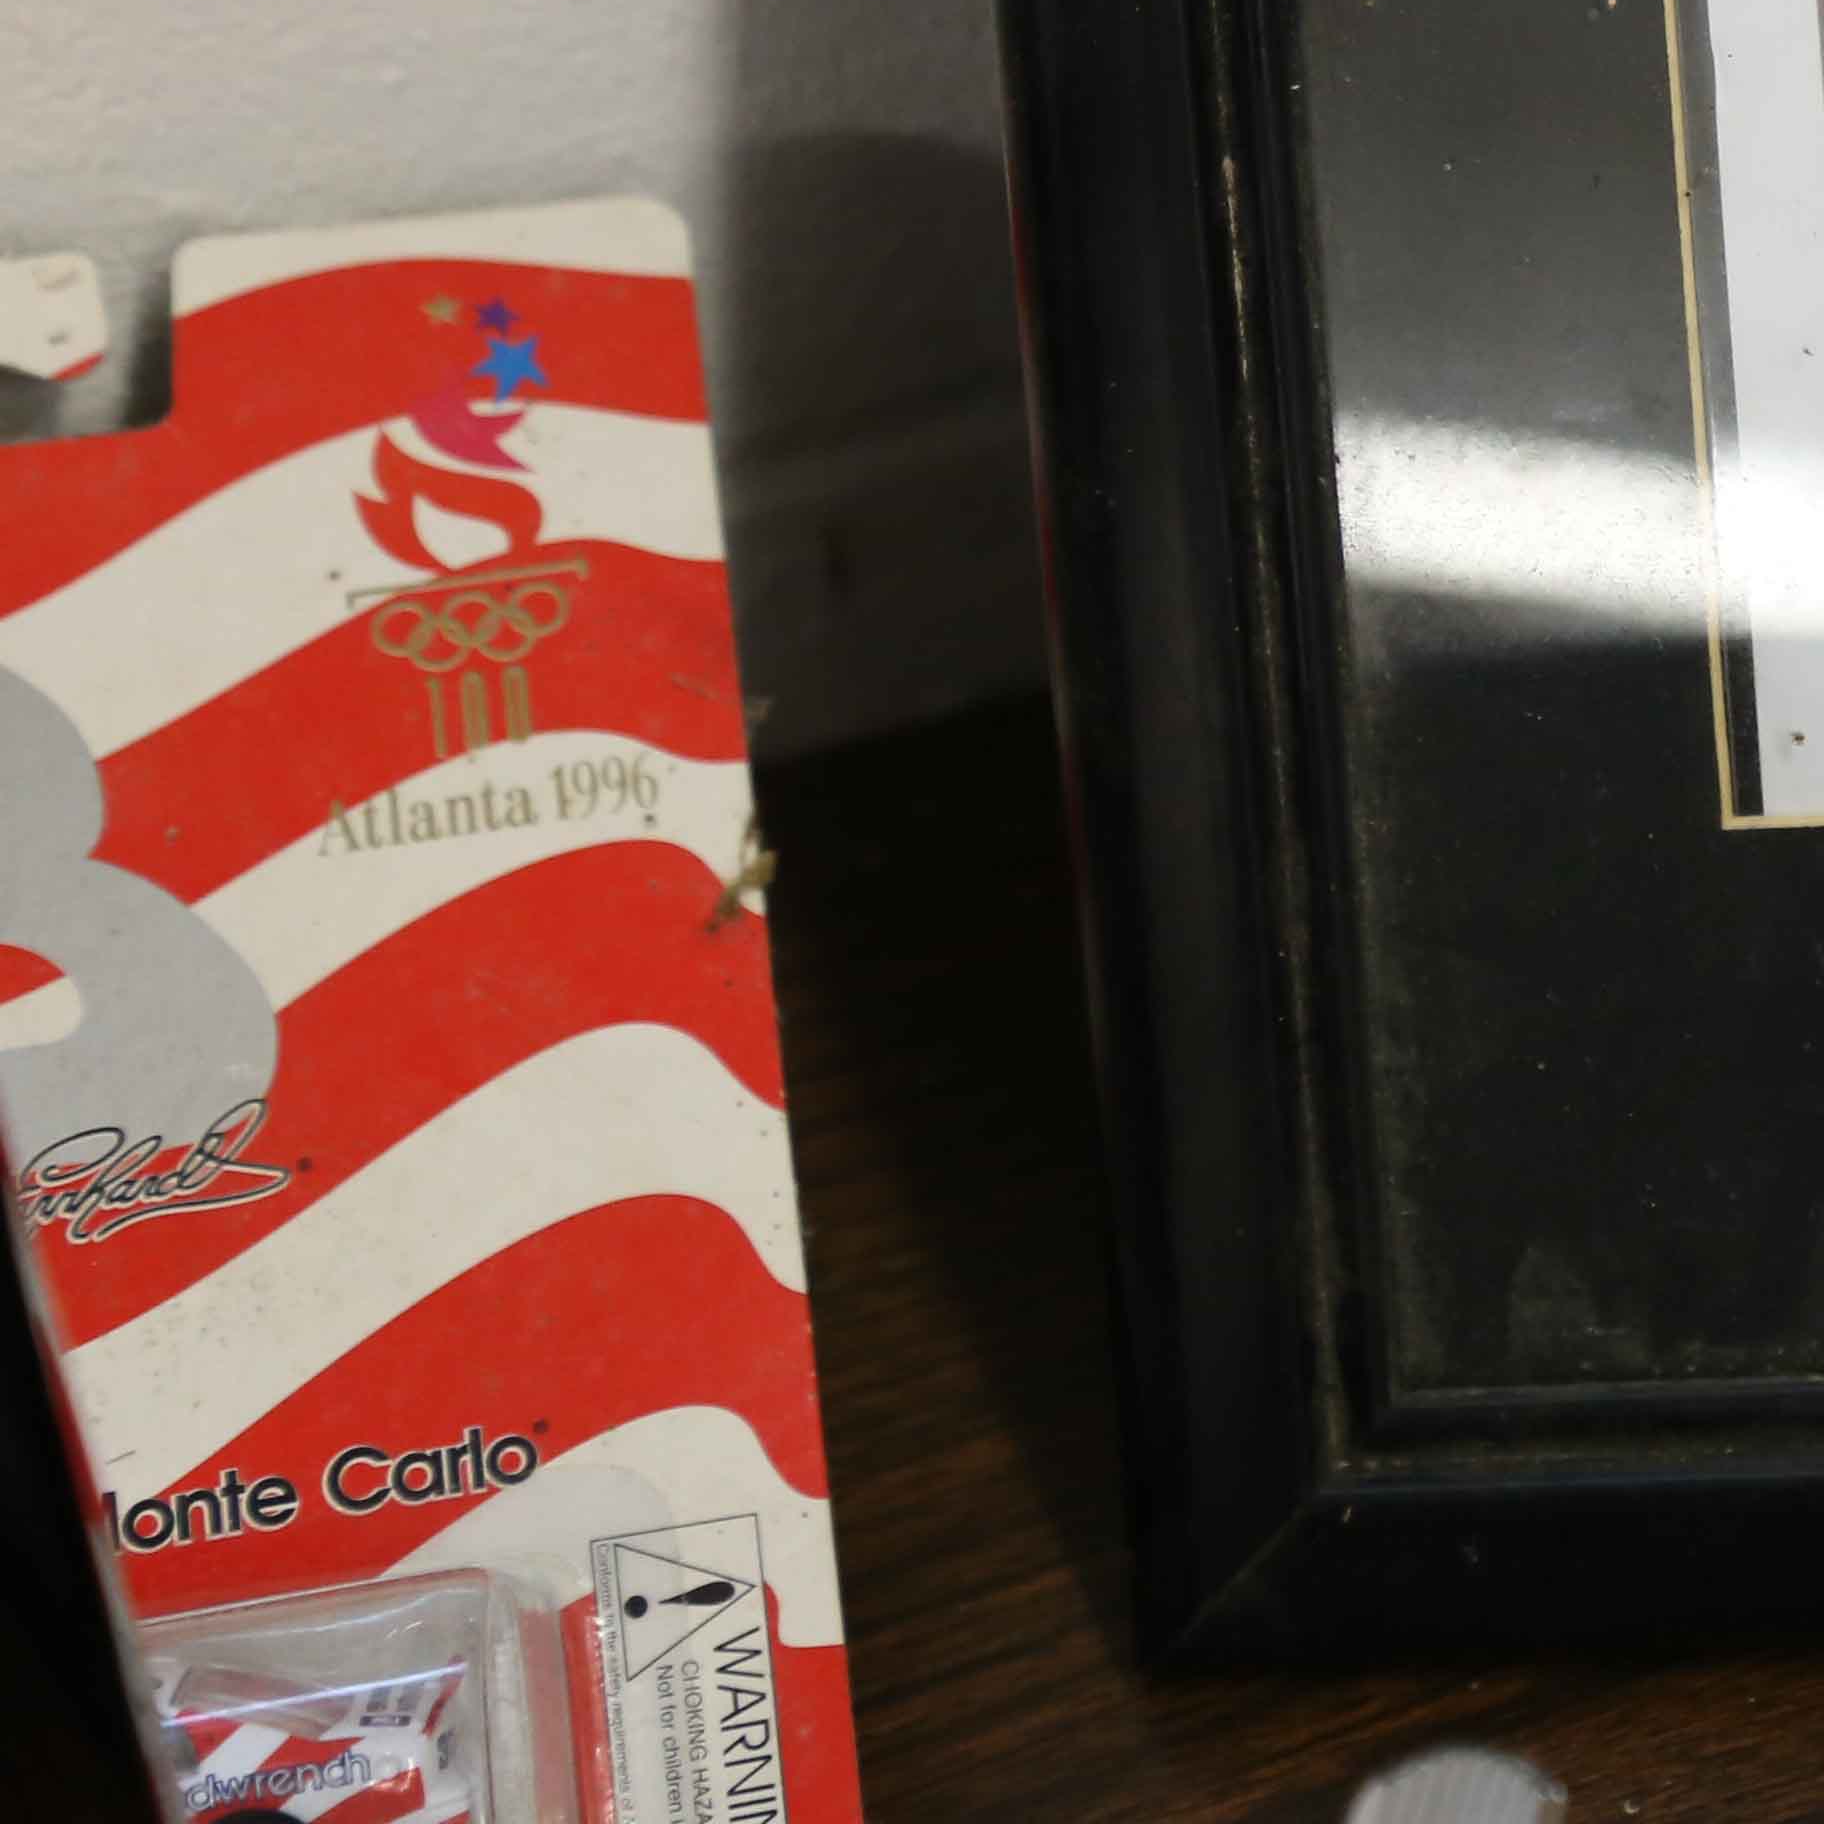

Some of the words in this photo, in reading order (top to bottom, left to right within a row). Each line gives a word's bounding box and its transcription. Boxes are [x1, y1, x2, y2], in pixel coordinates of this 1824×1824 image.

[318, 778, 541, 858] Atlanta
[551, 752, 661, 822] 1996
[322, 1425, 540, 1517] Carlo
[656, 1664, 676, 1700] Not
[659, 1701, 679, 1729] for
[680, 1659, 709, 1764] CHOKING
[662, 1735, 682, 1813] children
